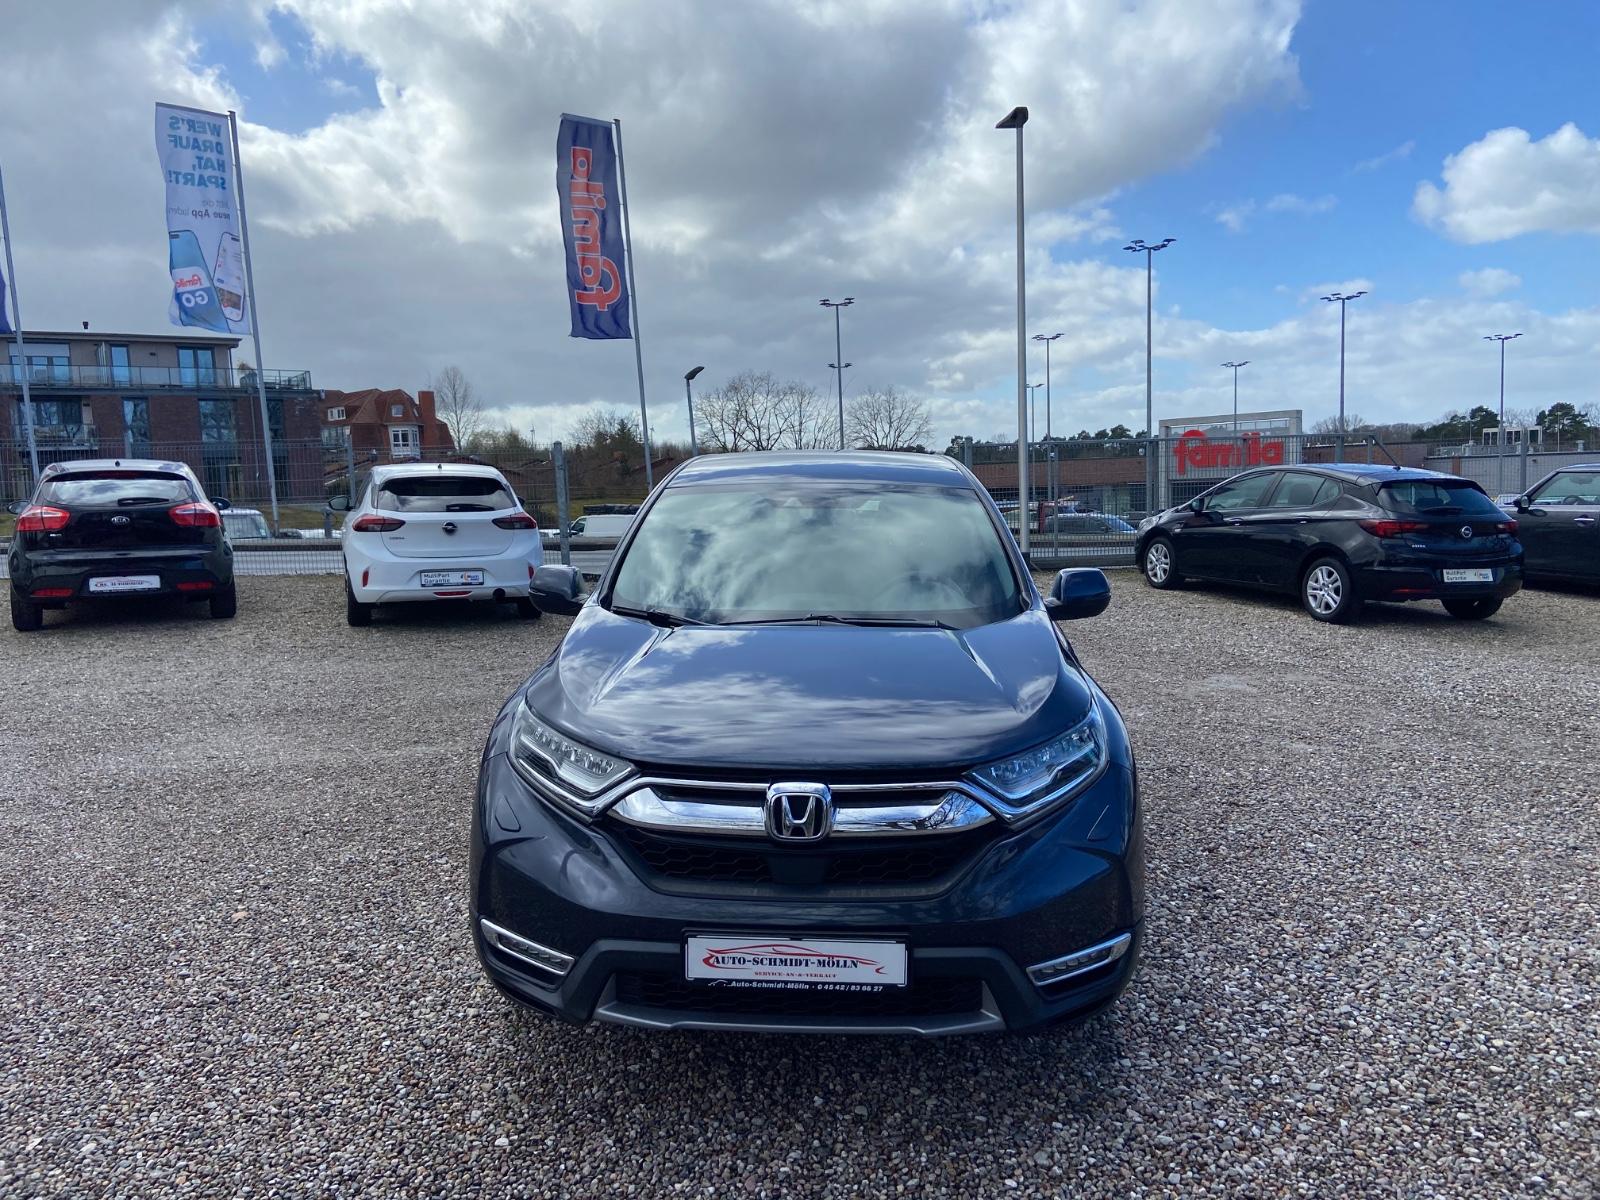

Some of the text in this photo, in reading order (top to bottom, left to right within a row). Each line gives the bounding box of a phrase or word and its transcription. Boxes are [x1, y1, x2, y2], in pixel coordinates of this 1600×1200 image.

[1173, 429, 1284, 475] famila
[712, 956, 859, 969] AUTO-SCHMIDT-MÖLLN
[731, 981, 809, 990] Auto-Schmidt-Mölln
